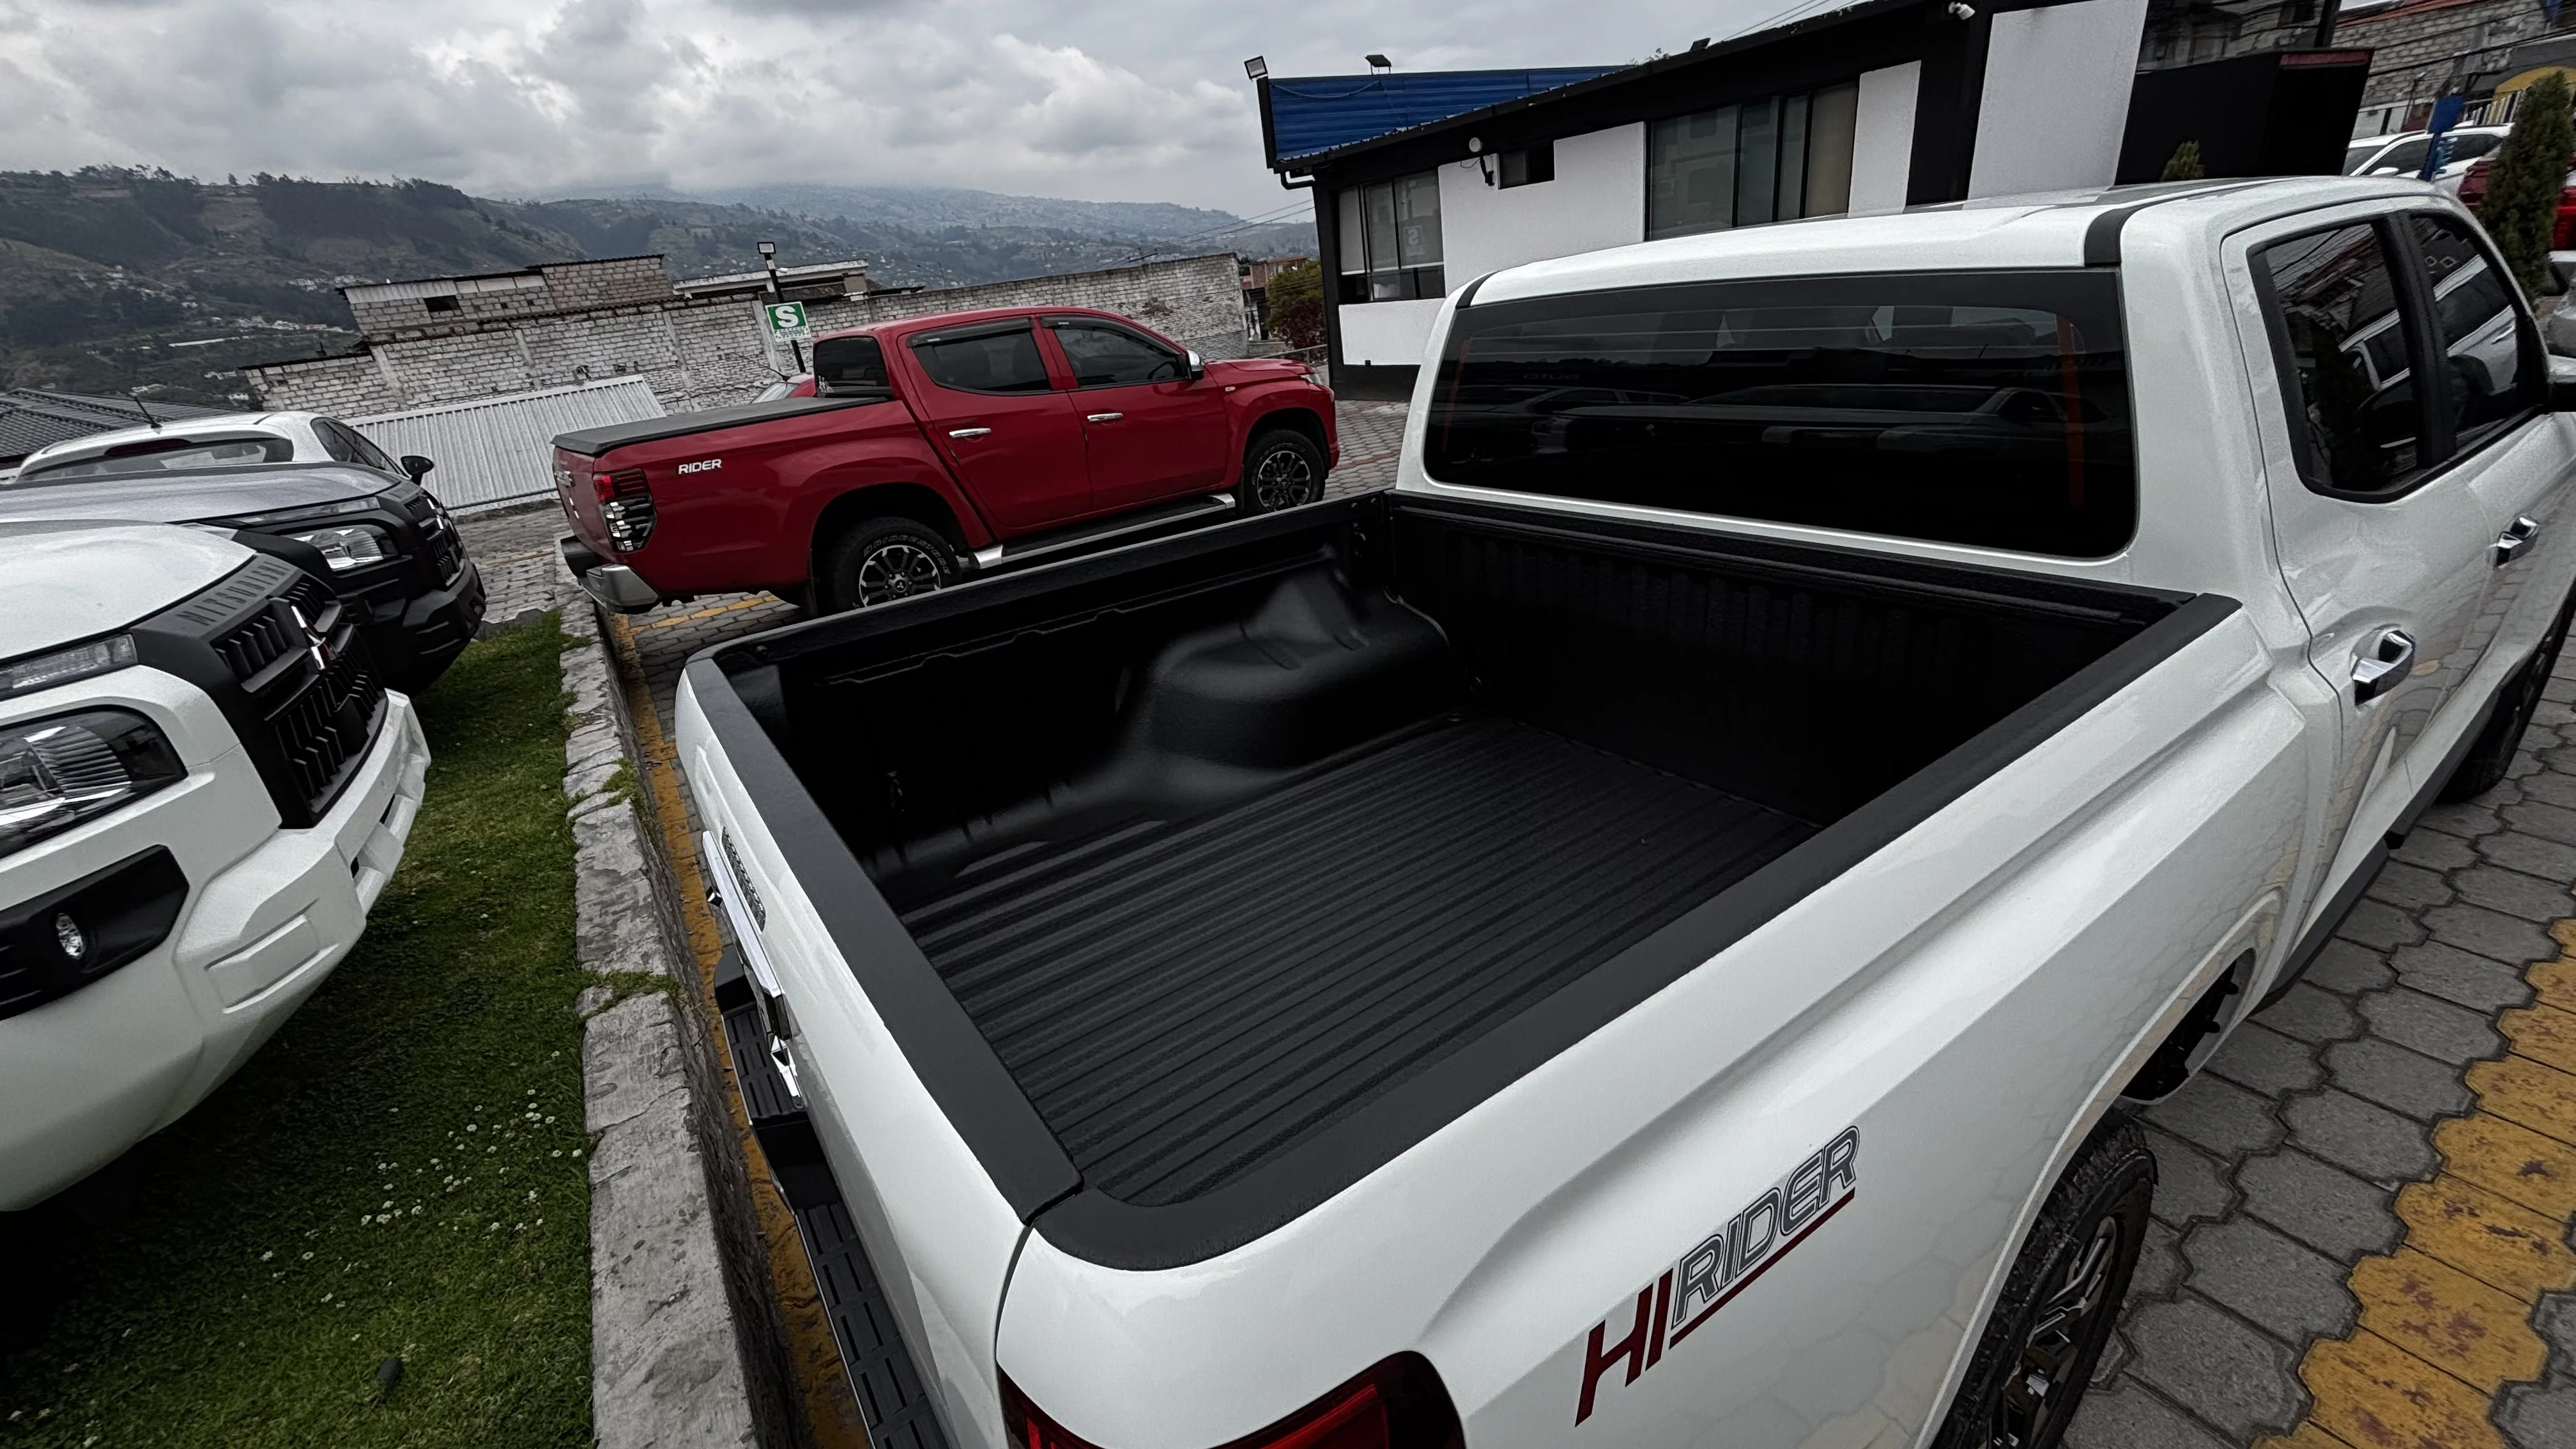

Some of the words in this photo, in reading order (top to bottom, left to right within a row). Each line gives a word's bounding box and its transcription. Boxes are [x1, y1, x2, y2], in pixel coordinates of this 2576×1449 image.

[775, 305, 799, 328] S
[678, 459, 723, 475] RIDER
[175, 560, 291, 626] MITSUBISHI
